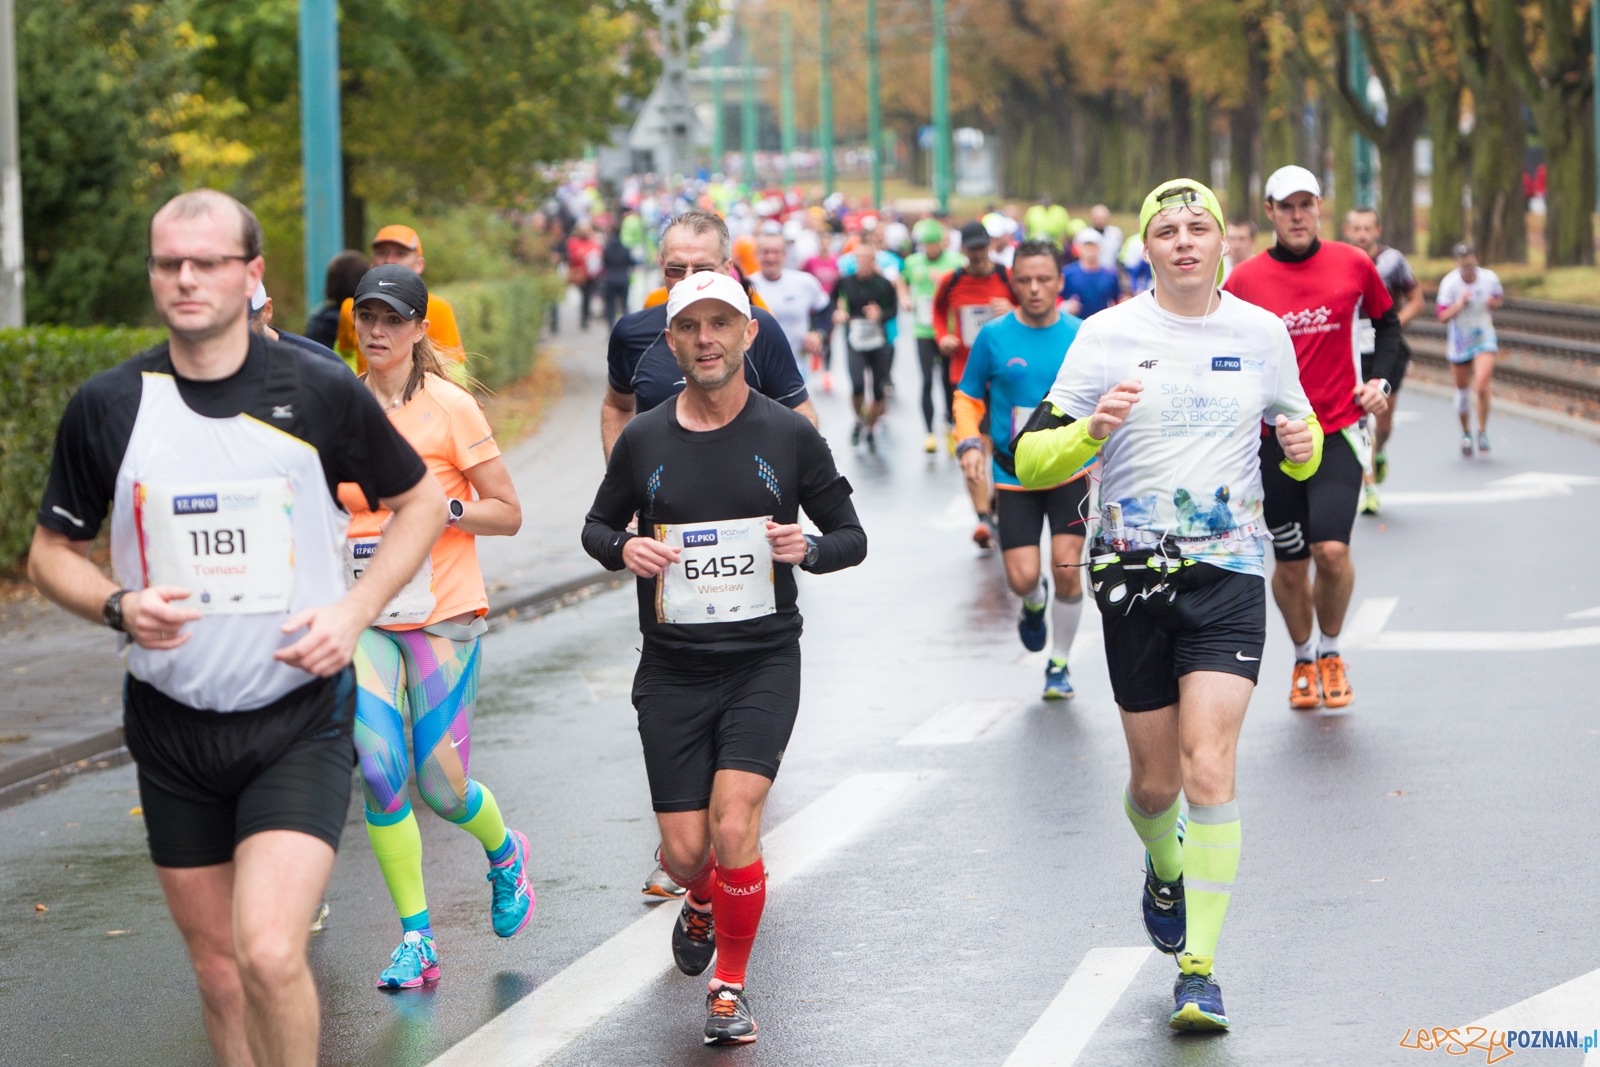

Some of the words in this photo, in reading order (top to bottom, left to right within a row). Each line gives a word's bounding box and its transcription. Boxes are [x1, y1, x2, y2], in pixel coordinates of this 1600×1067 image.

[1138, 360, 1159, 369] 4F
[1214, 360, 1240, 368] 17.PKO
[1161, 384, 1194, 394] SIŁA
[1171, 397, 1240, 408] ODWAGA
[1161, 408, 1240, 422] SZYBKOŚĆ
[188, 529, 246, 556] 1181
[685, 533, 716, 544] 17.PKO
[192, 563, 248, 576] Tomasz
[685, 554, 754, 580] 6452
[697, 583, 744, 595] Wiesław
[723, 883, 748, 894] ROYAL
[749, 880, 763, 892] BAY
